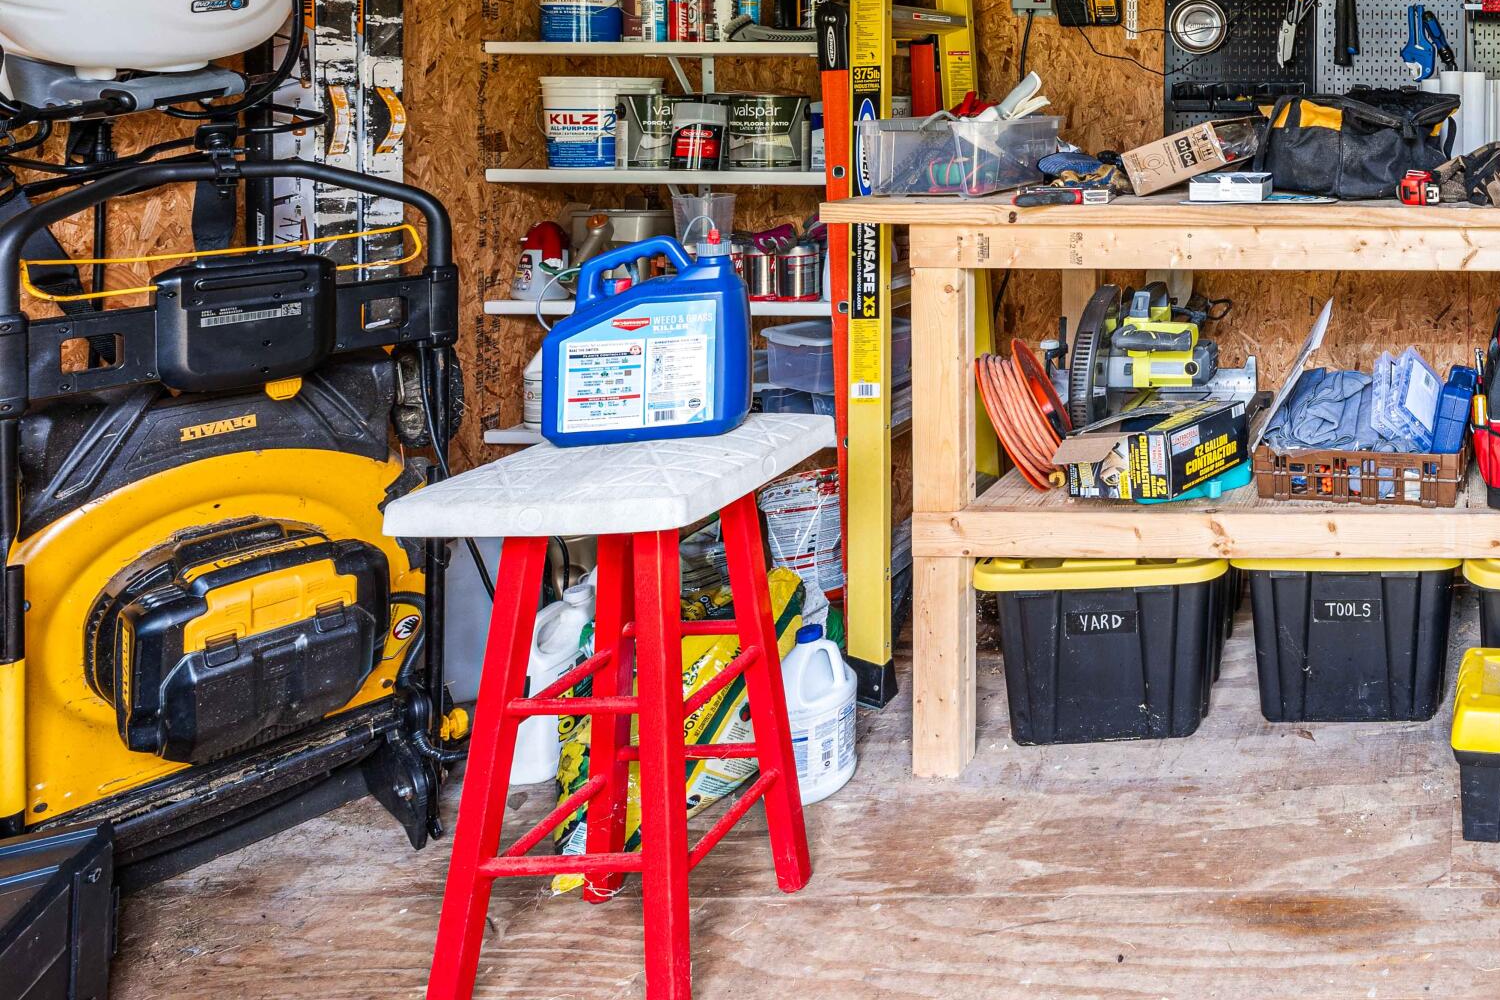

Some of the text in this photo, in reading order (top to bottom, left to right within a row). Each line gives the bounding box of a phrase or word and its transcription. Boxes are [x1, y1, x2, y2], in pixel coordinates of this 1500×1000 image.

[655, 2, 665, 22] ALEX
[679, 8, 688, 38] LOCTITE
[854, 68, 880, 79] 375lb
[549, 113, 598, 125] KILZ
[734, 105, 782, 117] valspar
[863, 223, 876, 293] EANSAFE
[863, 295, 876, 317] X3
[653, 315, 675, 325] WEED
[686, 312, 713, 322] GRASS
[653, 324, 689, 332] KILLER
[1194, 433, 1228, 457] 42 GALLON
[1138, 435, 1150, 497] CONTRACTOR
[1185, 441, 1237, 475] CONTRACTOR
[1157, 477, 1167, 495] 42
[1324, 601, 1373, 618] TOOLS
[1079, 611, 1124, 631] YARD
